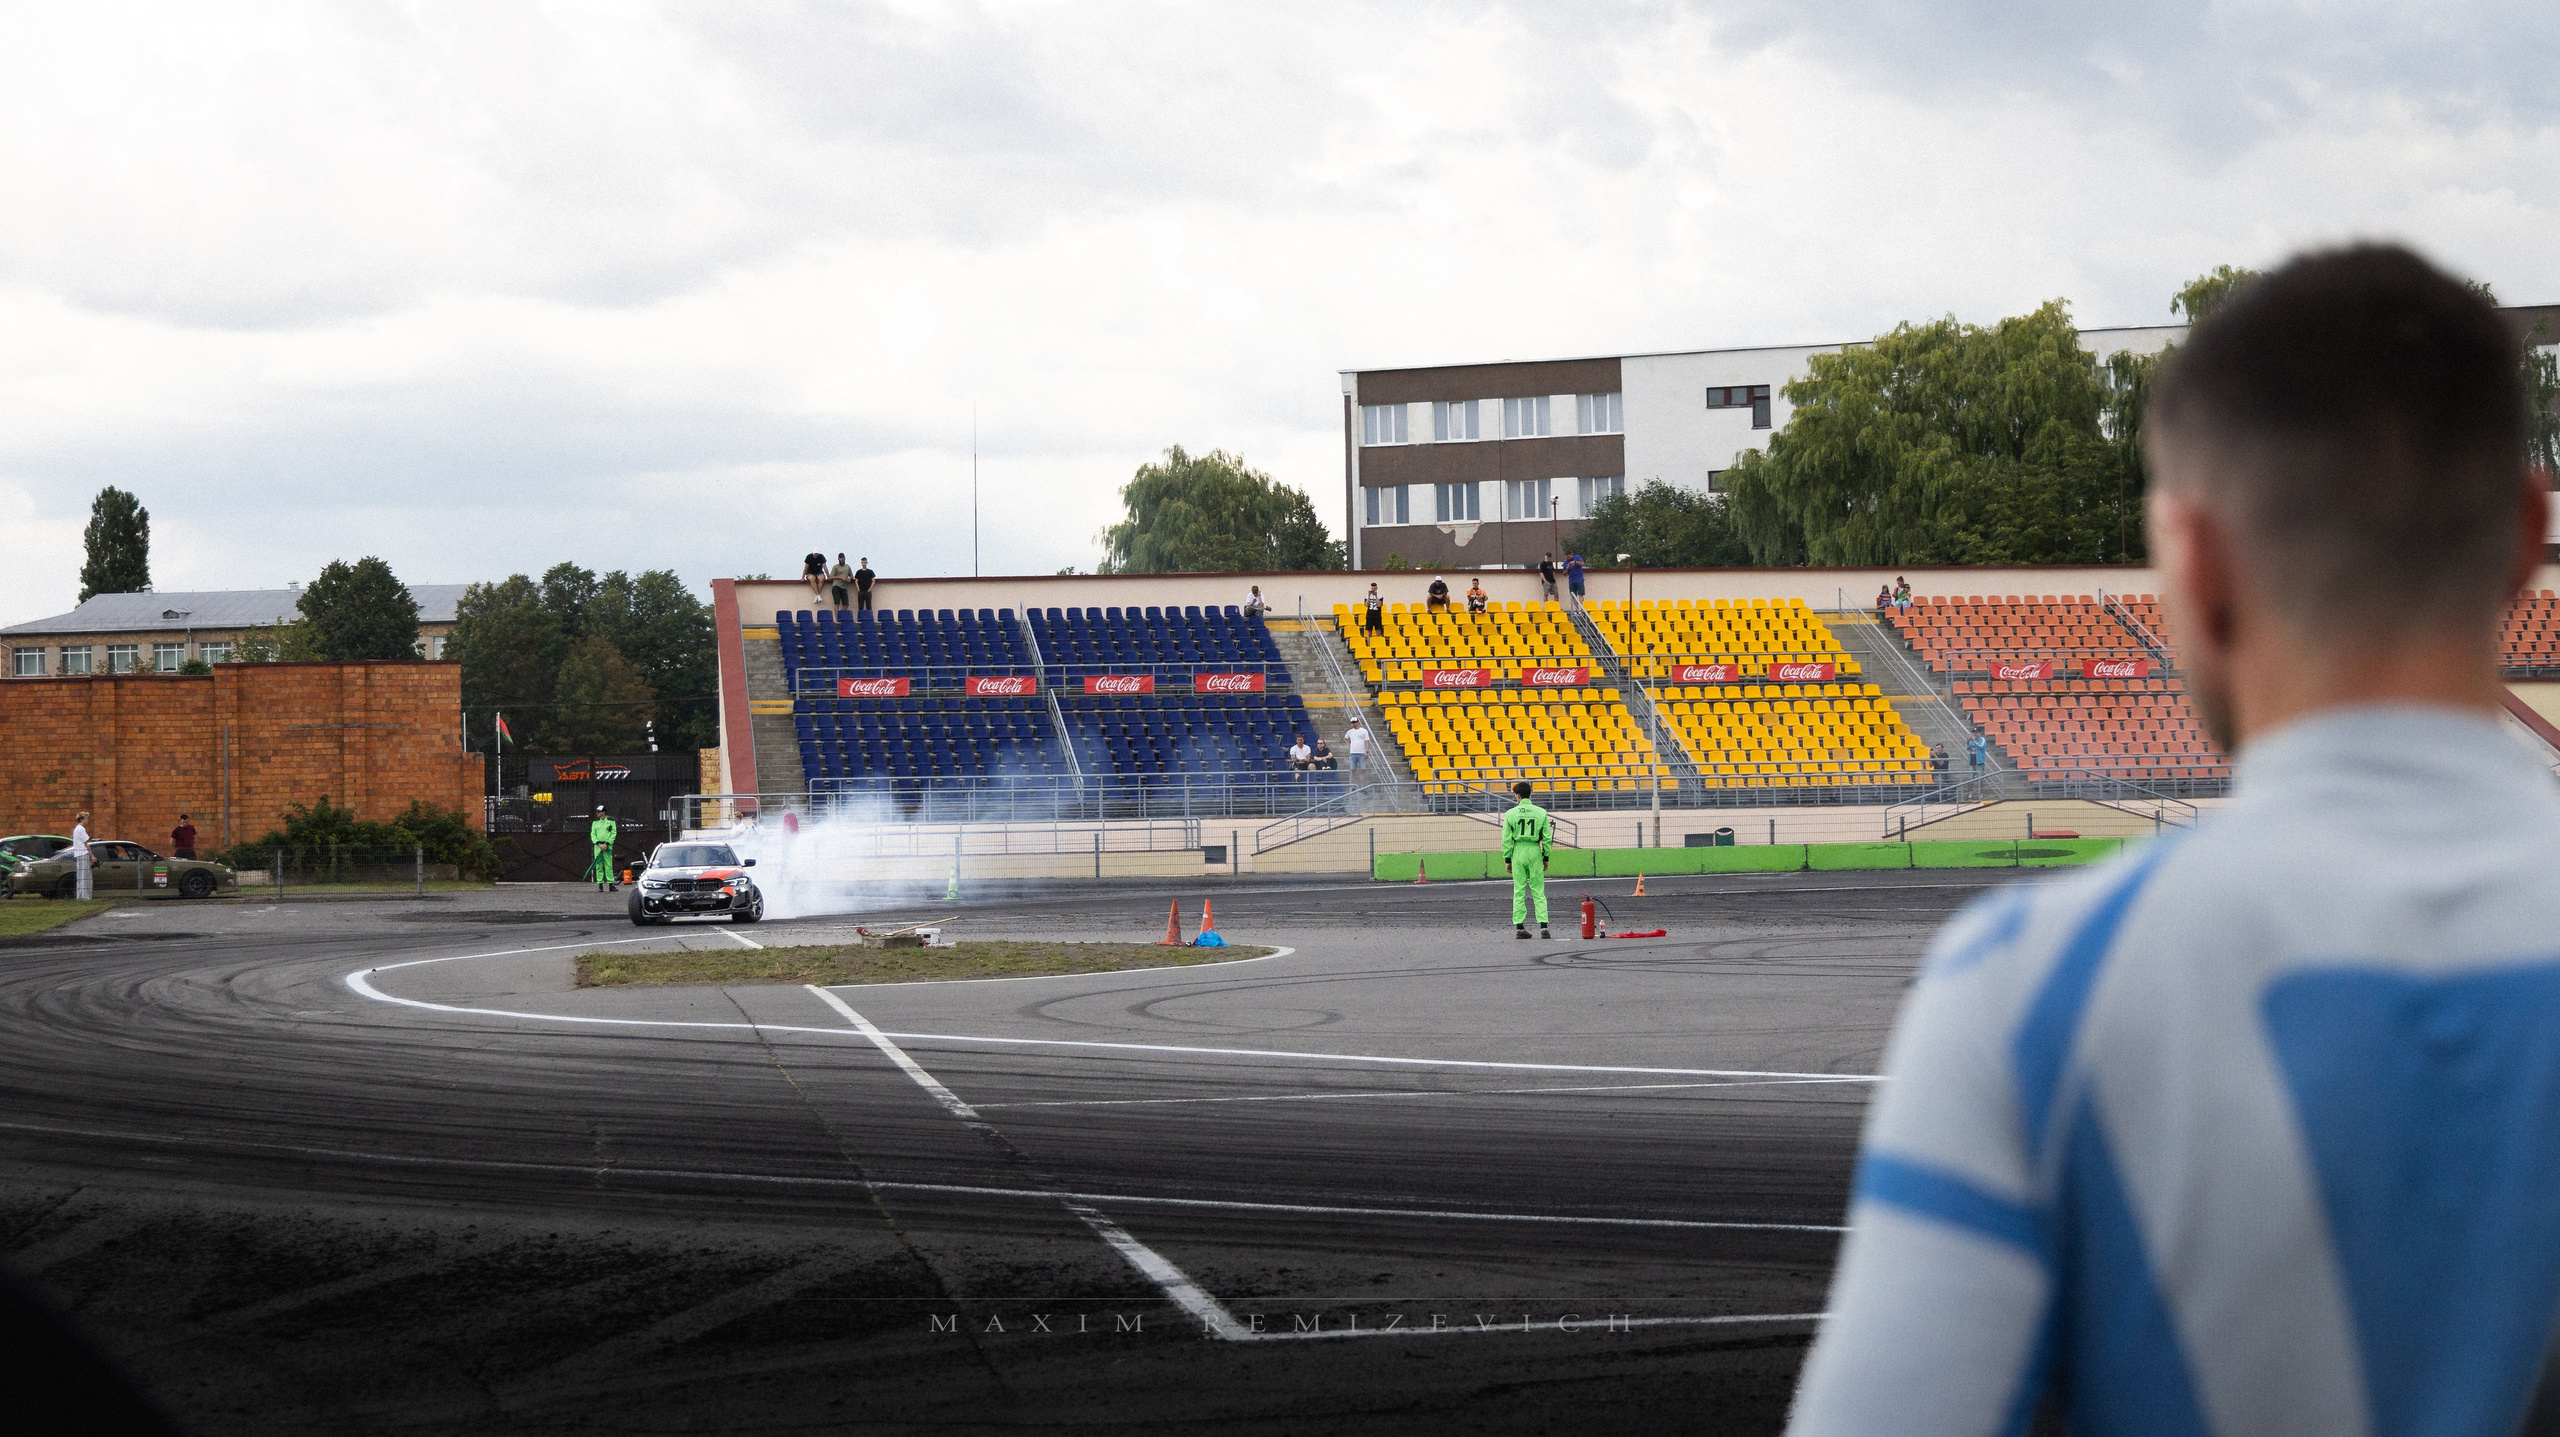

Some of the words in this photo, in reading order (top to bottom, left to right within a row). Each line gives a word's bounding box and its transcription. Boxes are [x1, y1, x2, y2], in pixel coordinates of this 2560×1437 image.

[1532, 668, 1577, 684] Coca-Cola
[1682, 665, 1727, 681] Coca-Cola
[1779, 664, 1823, 679] Coca-Cola
[1999, 664, 2041, 679] Coca-Cola
[2093, 661, 2136, 676] Coca-Cola
[1095, 676, 1142, 692] Coca-Cola
[1206, 674, 1253, 690] Coca-Cola
[1434, 670, 1479, 685] Coca-Cola
[849, 679, 898, 695] Coca-Cola
[976, 678, 1023, 694] Coca-Cola
[1517, 819, 1535, 836] 11
